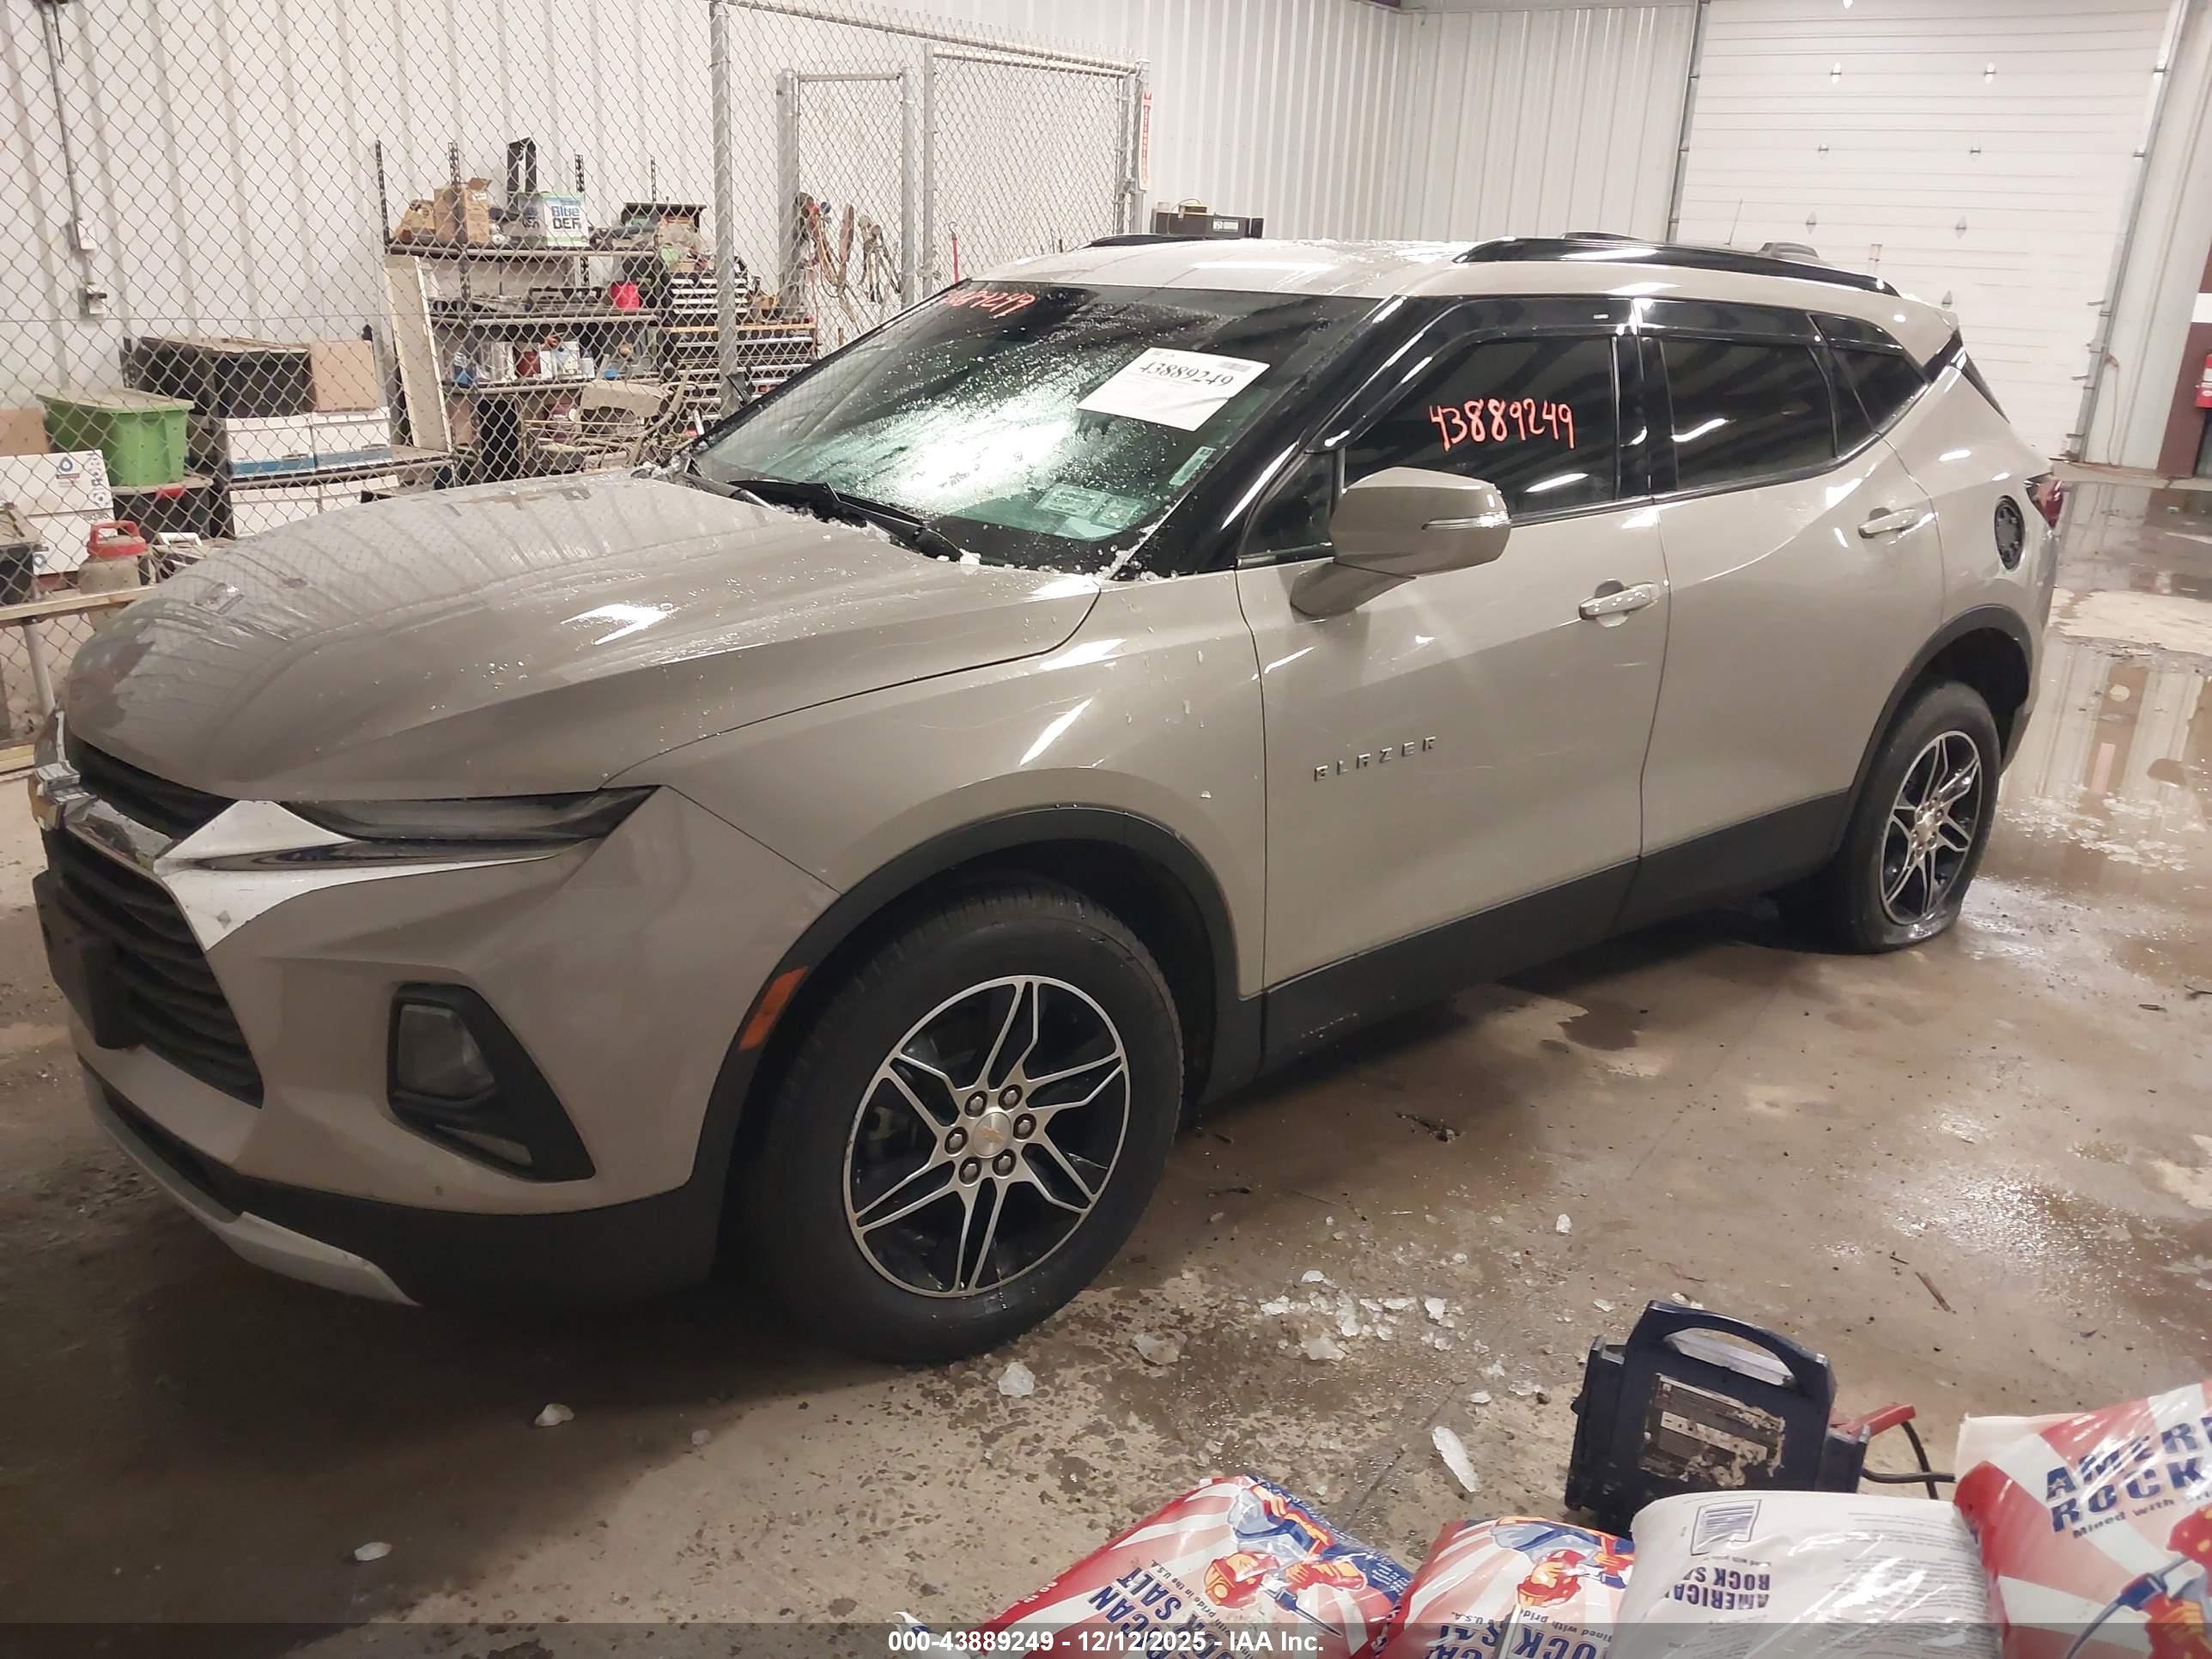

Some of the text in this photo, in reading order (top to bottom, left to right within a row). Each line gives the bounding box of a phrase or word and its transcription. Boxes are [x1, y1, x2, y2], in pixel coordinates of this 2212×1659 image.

[551, 205, 580, 216] Blue
[552, 217, 581, 229] DEF
[1139, 362, 1234, 386] 43889249
[1430, 398, 1575, 452] 43889249
[1313, 736, 1437, 782] BLAZER
[2051, 1456, 2205, 1533] ROCK
[1171, 1577, 1185, 1590] the
[1713, 1567, 1770, 1590] ROCK
[1116, 1567, 1182, 1620] SALT
[1184, 1588, 1195, 1598] in
[1194, 1596, 1216, 1618] pride
[1519, 1610, 1549, 1623] prid
[1552, 1620, 1577, 1633] with
